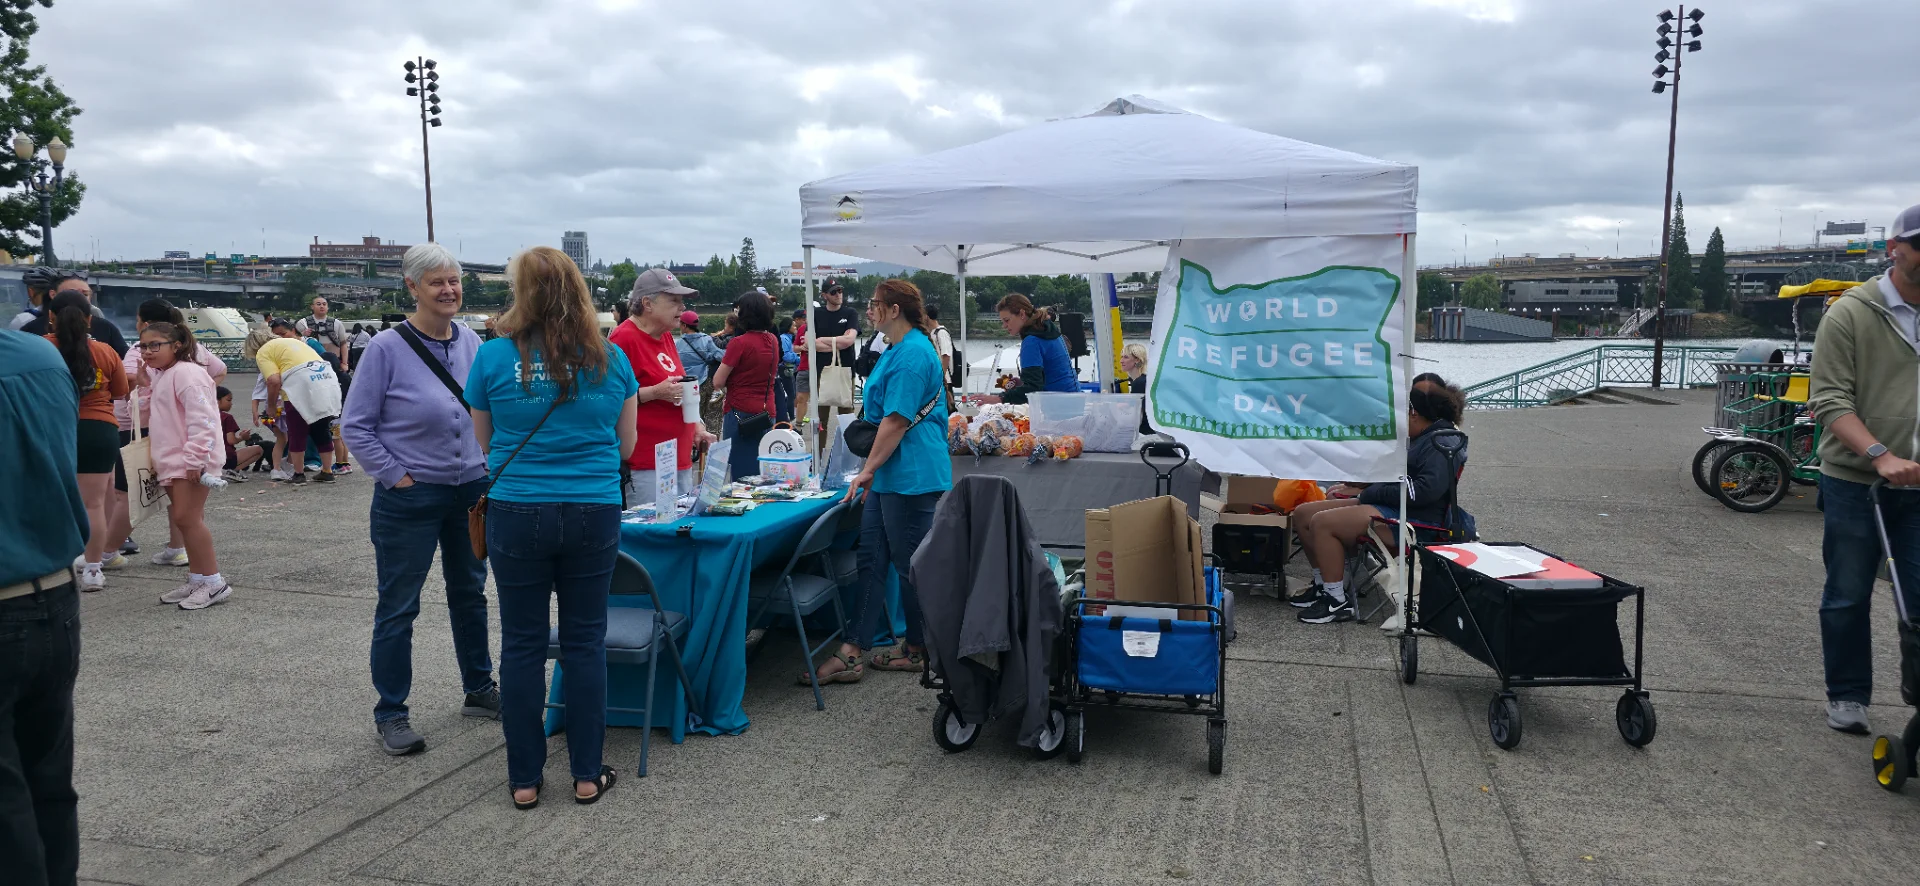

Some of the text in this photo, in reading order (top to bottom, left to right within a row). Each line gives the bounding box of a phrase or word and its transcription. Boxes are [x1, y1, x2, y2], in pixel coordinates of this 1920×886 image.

[1206, 297, 1338, 324] WORLD
[1177, 336, 1373, 369] REFUGEE
[1234, 394, 1308, 415] DAY
